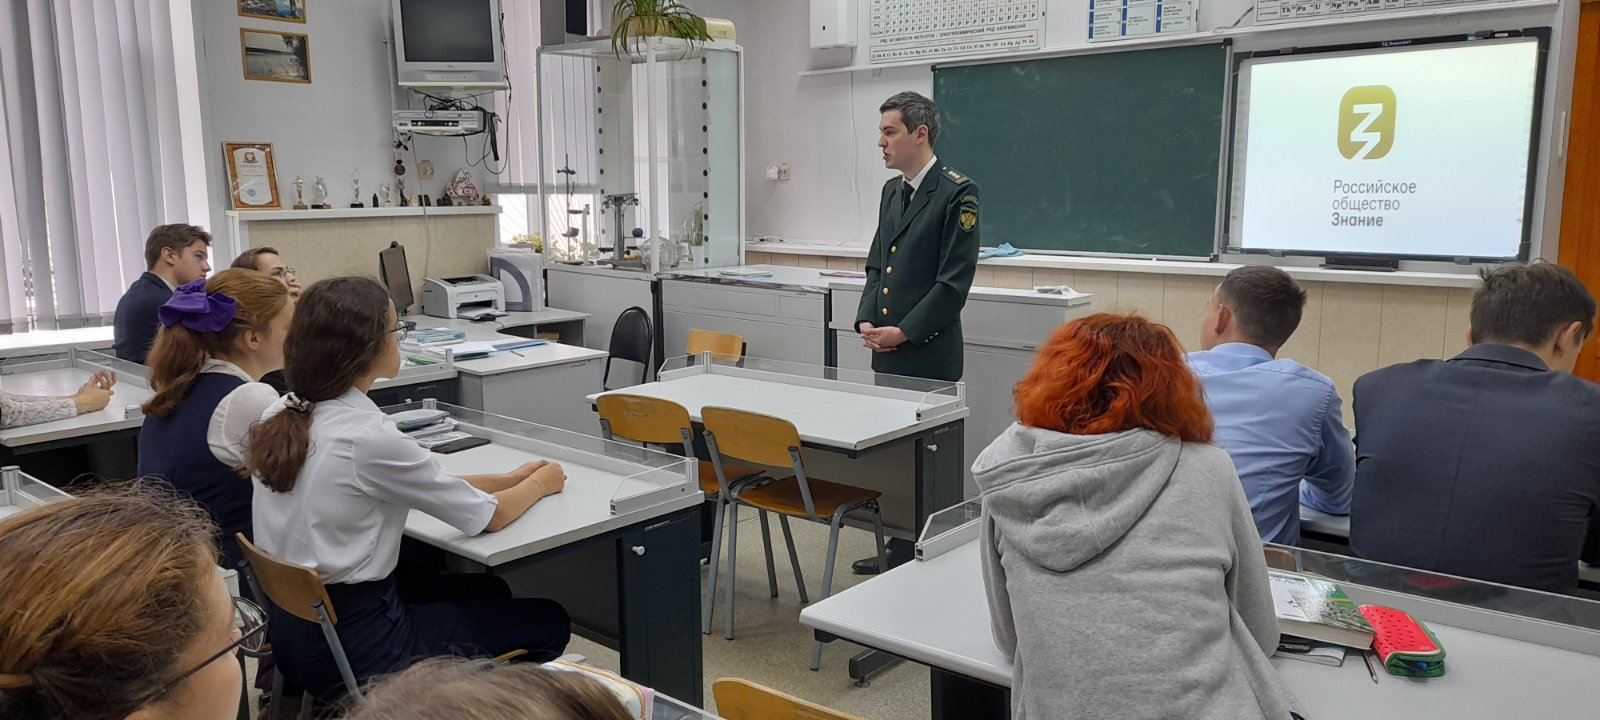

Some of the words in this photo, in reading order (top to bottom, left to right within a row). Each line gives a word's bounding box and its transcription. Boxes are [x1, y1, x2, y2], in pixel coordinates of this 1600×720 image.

[1333, 179, 1417, 194] Российское
[1332, 196, 1400, 212] общество
[1331, 212, 1383, 227] Знание
